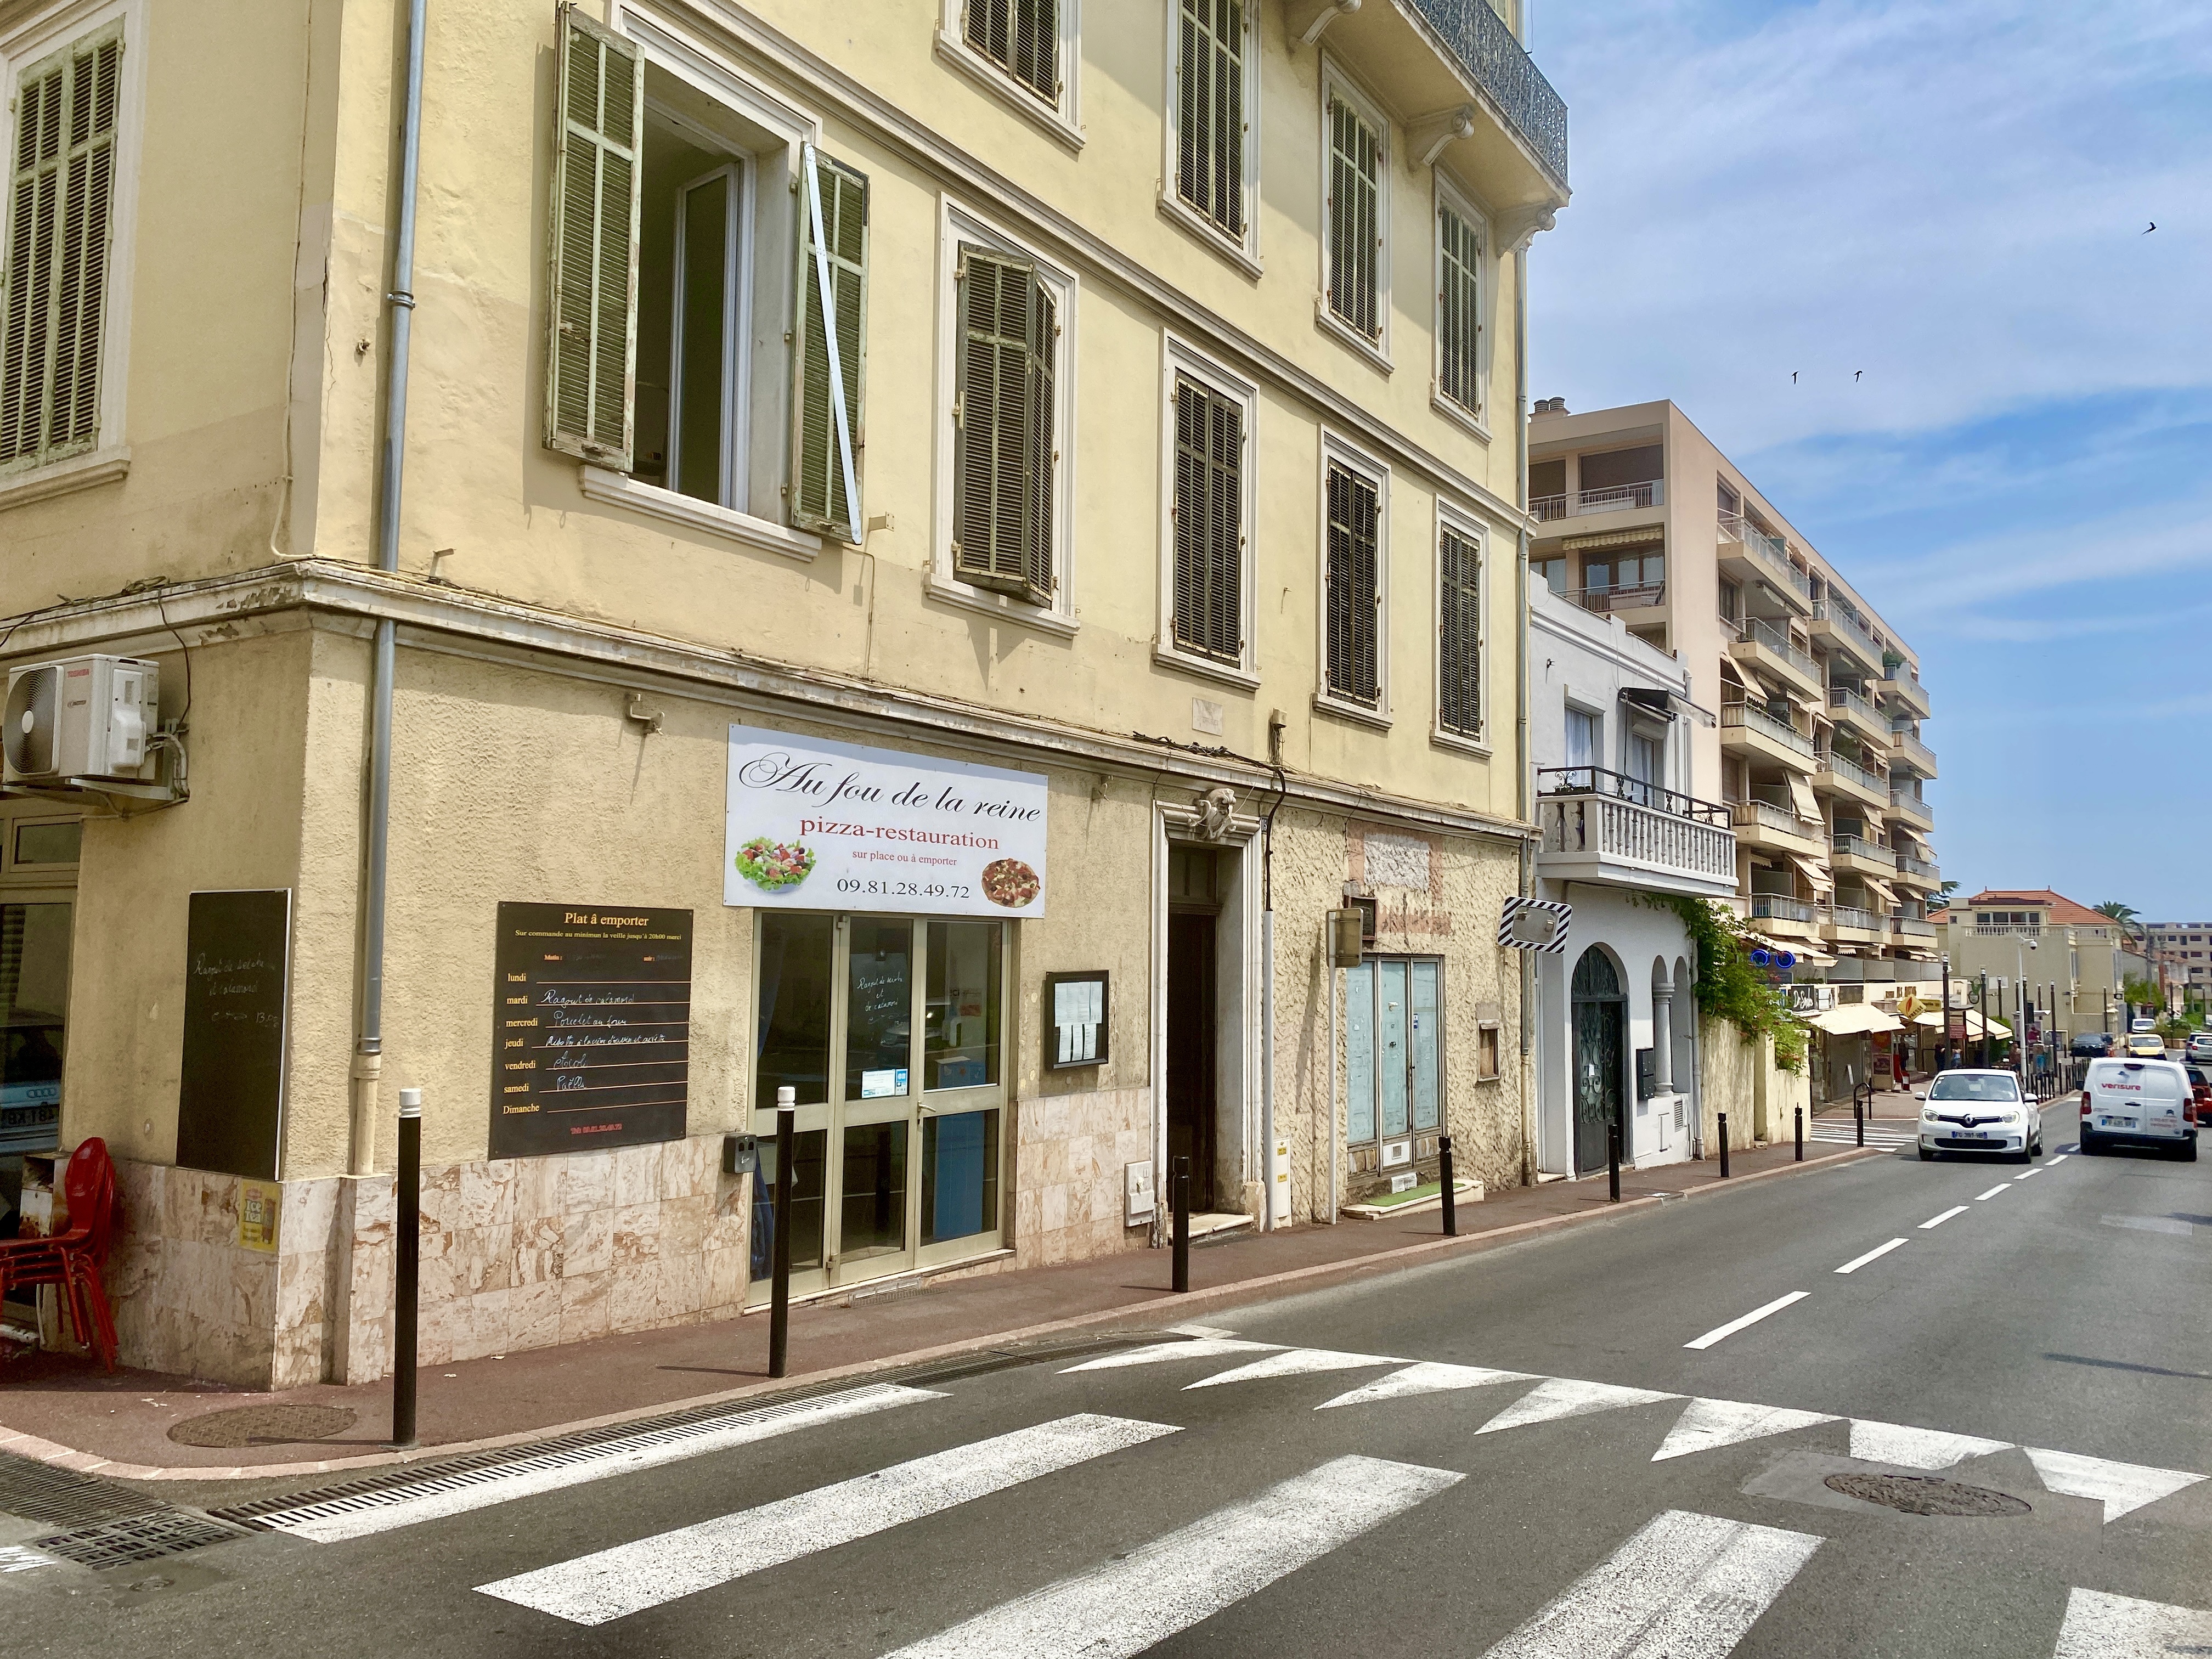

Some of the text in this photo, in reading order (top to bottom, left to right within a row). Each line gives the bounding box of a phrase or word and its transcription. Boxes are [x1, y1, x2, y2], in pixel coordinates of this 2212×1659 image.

[738, 752, 1041, 822] Au fou de la reine
[799, 816, 1000, 850] pizza-restauration
[853, 851, 867, 860] sur
[870, 850, 895, 862] place
[911, 853, 917, 862] à
[918, 855, 957, 867] emporter
[836, 878, 970, 899] 09.81.28.49.72
[564, 912, 588, 924] Plat
[600, 917, 649, 928] emporter
[507, 973, 527, 982] lundi
[506, 995, 528, 1005] mardi
[585, 994, 592, 1003] de
[1908, 1005, 1923, 1019] PRESSE
[505, 1017, 538, 1028] mercredi
[504, 1038, 524, 1050] jeudi
[504, 1059, 536, 1070] vendredi
[504, 1082, 529, 1093] samedi
[2101, 1082, 2141, 1091] verisure
[503, 1103, 540, 1115] Dimanche
